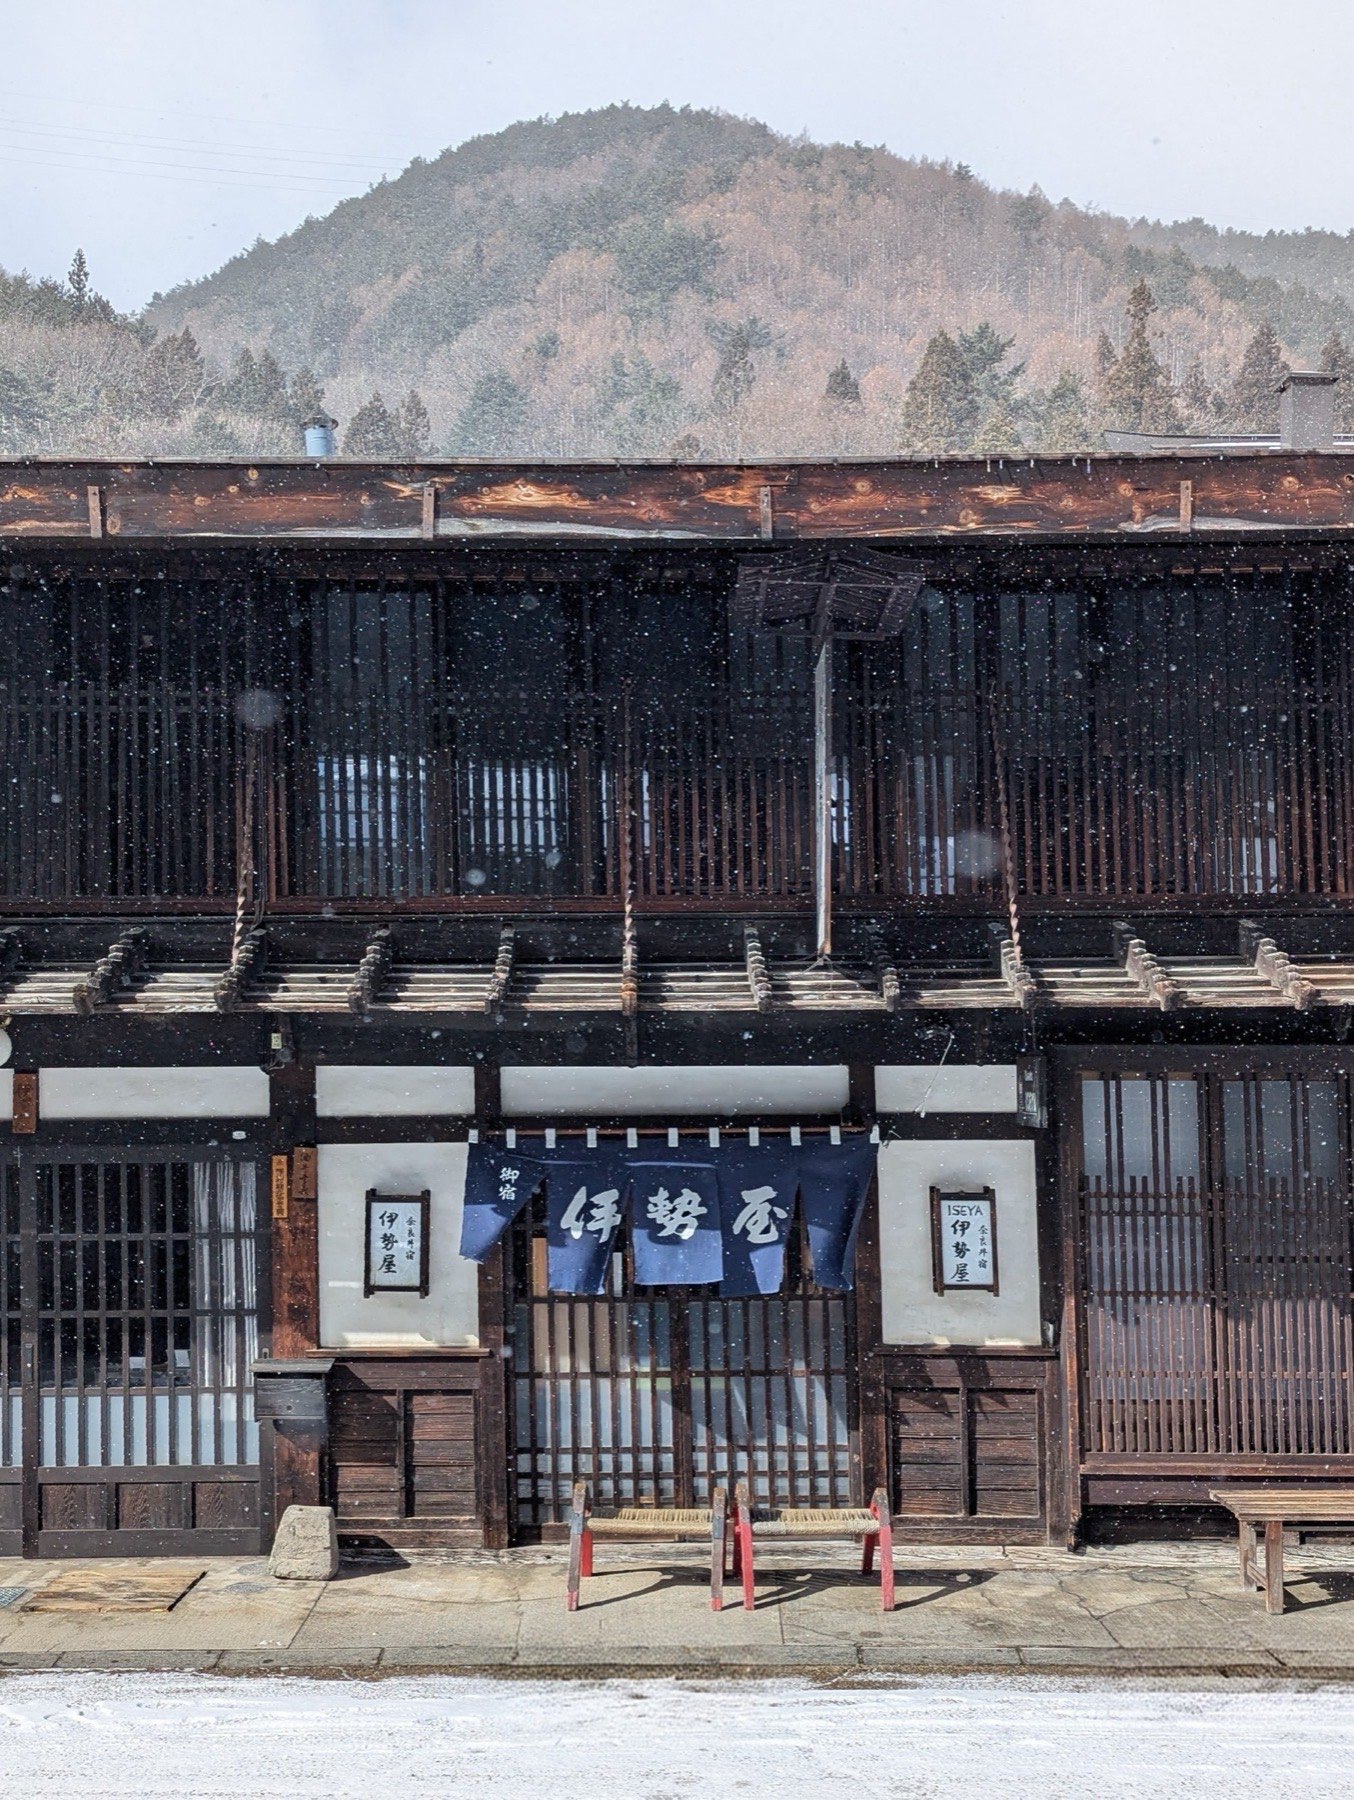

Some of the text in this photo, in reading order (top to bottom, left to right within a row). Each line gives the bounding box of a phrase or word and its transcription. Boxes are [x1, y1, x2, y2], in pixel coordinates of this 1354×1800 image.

[499, 1167, 520, 1201] 御宿
[560, 1185, 790, 1243] 伊勢屋
[947, 1204, 983, 1216] ISEYA
[377, 1210, 399, 1274] 伊勢屋
[405, 1216, 417, 1261] 奈良井宿
[950, 1219, 971, 1282] 伊勢屋
[978, 1224, 989, 1269] 奈良井宿
